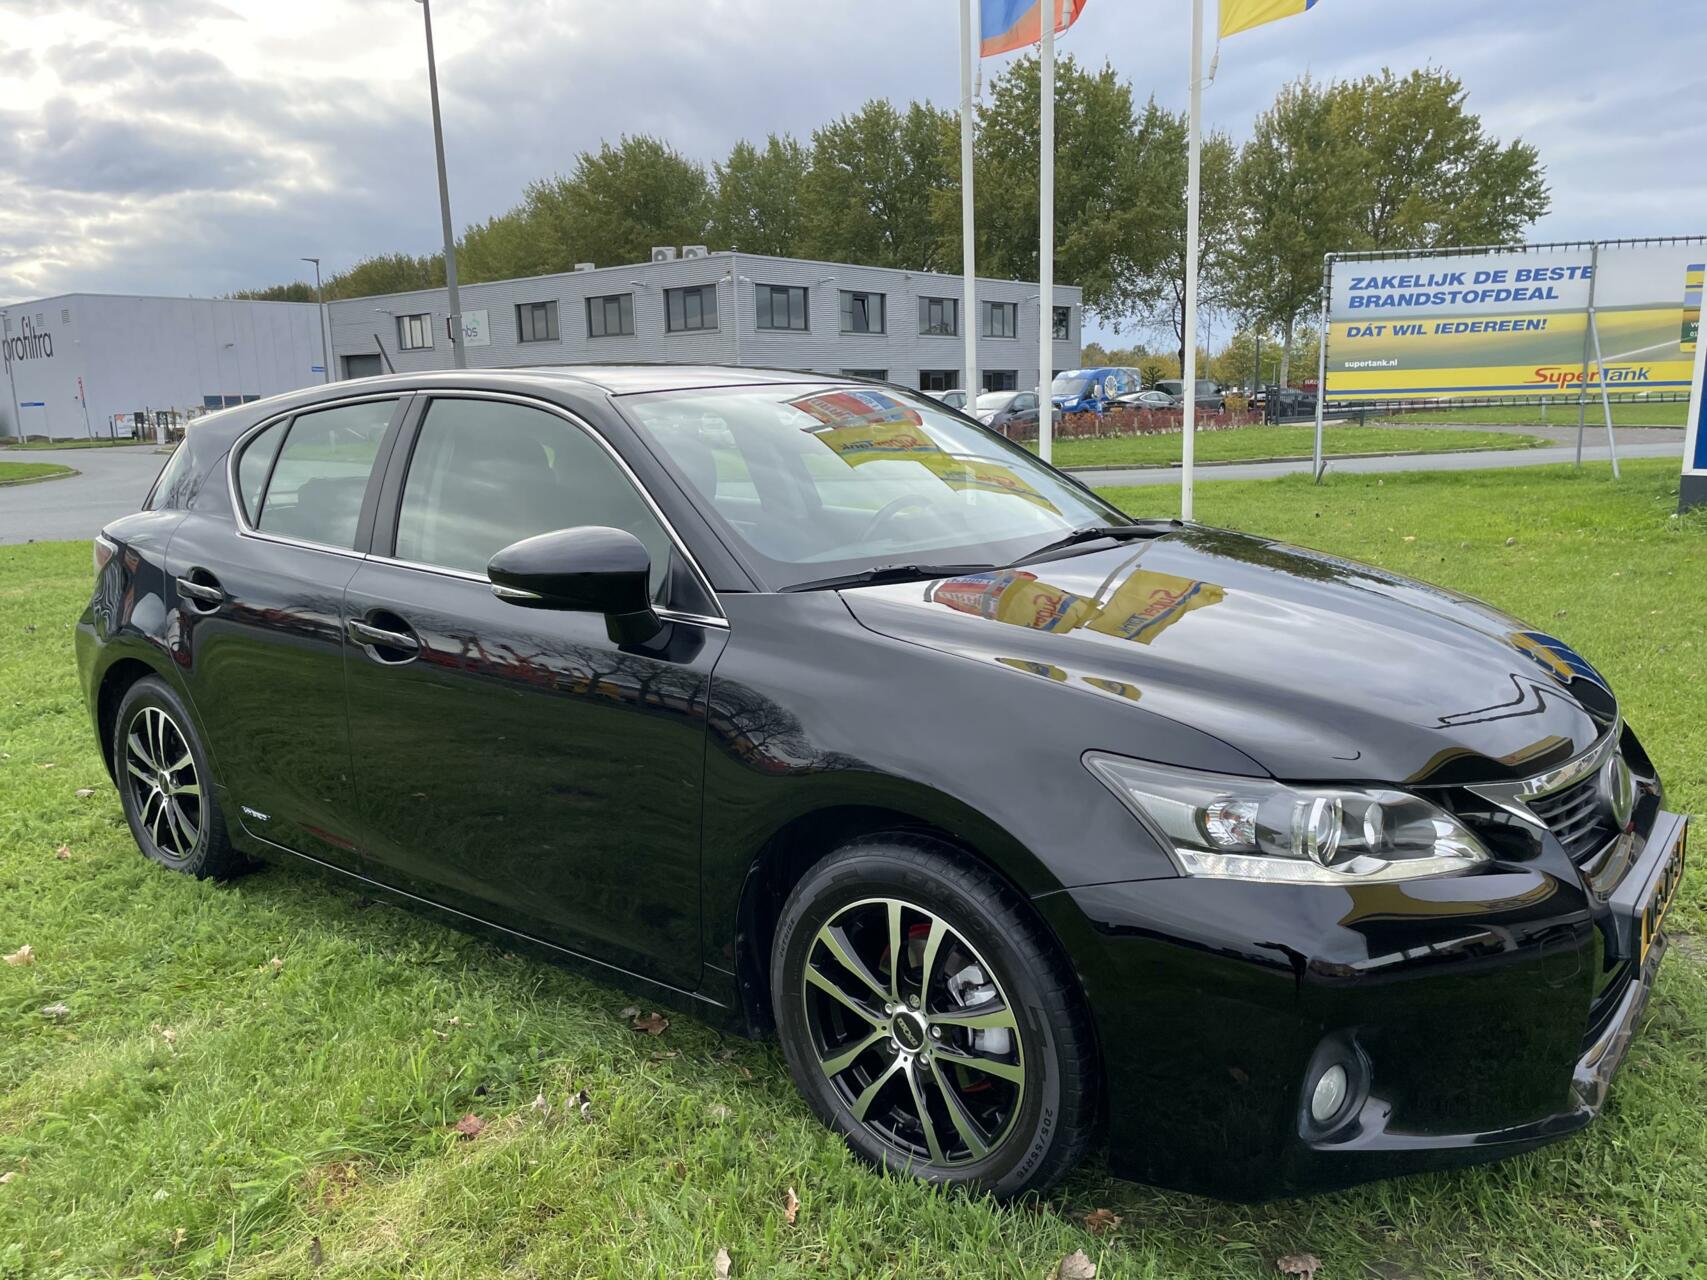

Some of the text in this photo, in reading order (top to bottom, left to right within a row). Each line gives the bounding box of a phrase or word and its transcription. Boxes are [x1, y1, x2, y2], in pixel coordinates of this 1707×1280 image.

[1348, 265, 1597, 291] ZAKELIJK DE BESTE
[1348, 286, 1559, 309] BRANDSTOFDEAL
[1346, 318, 1548, 338] DÁT WIL IEDEREEN!
[2, 315, 54, 375] profiltra
[1344, 358, 1398, 369] supertank.nl
[1015, 1108, 1055, 1181] 205/55R16
